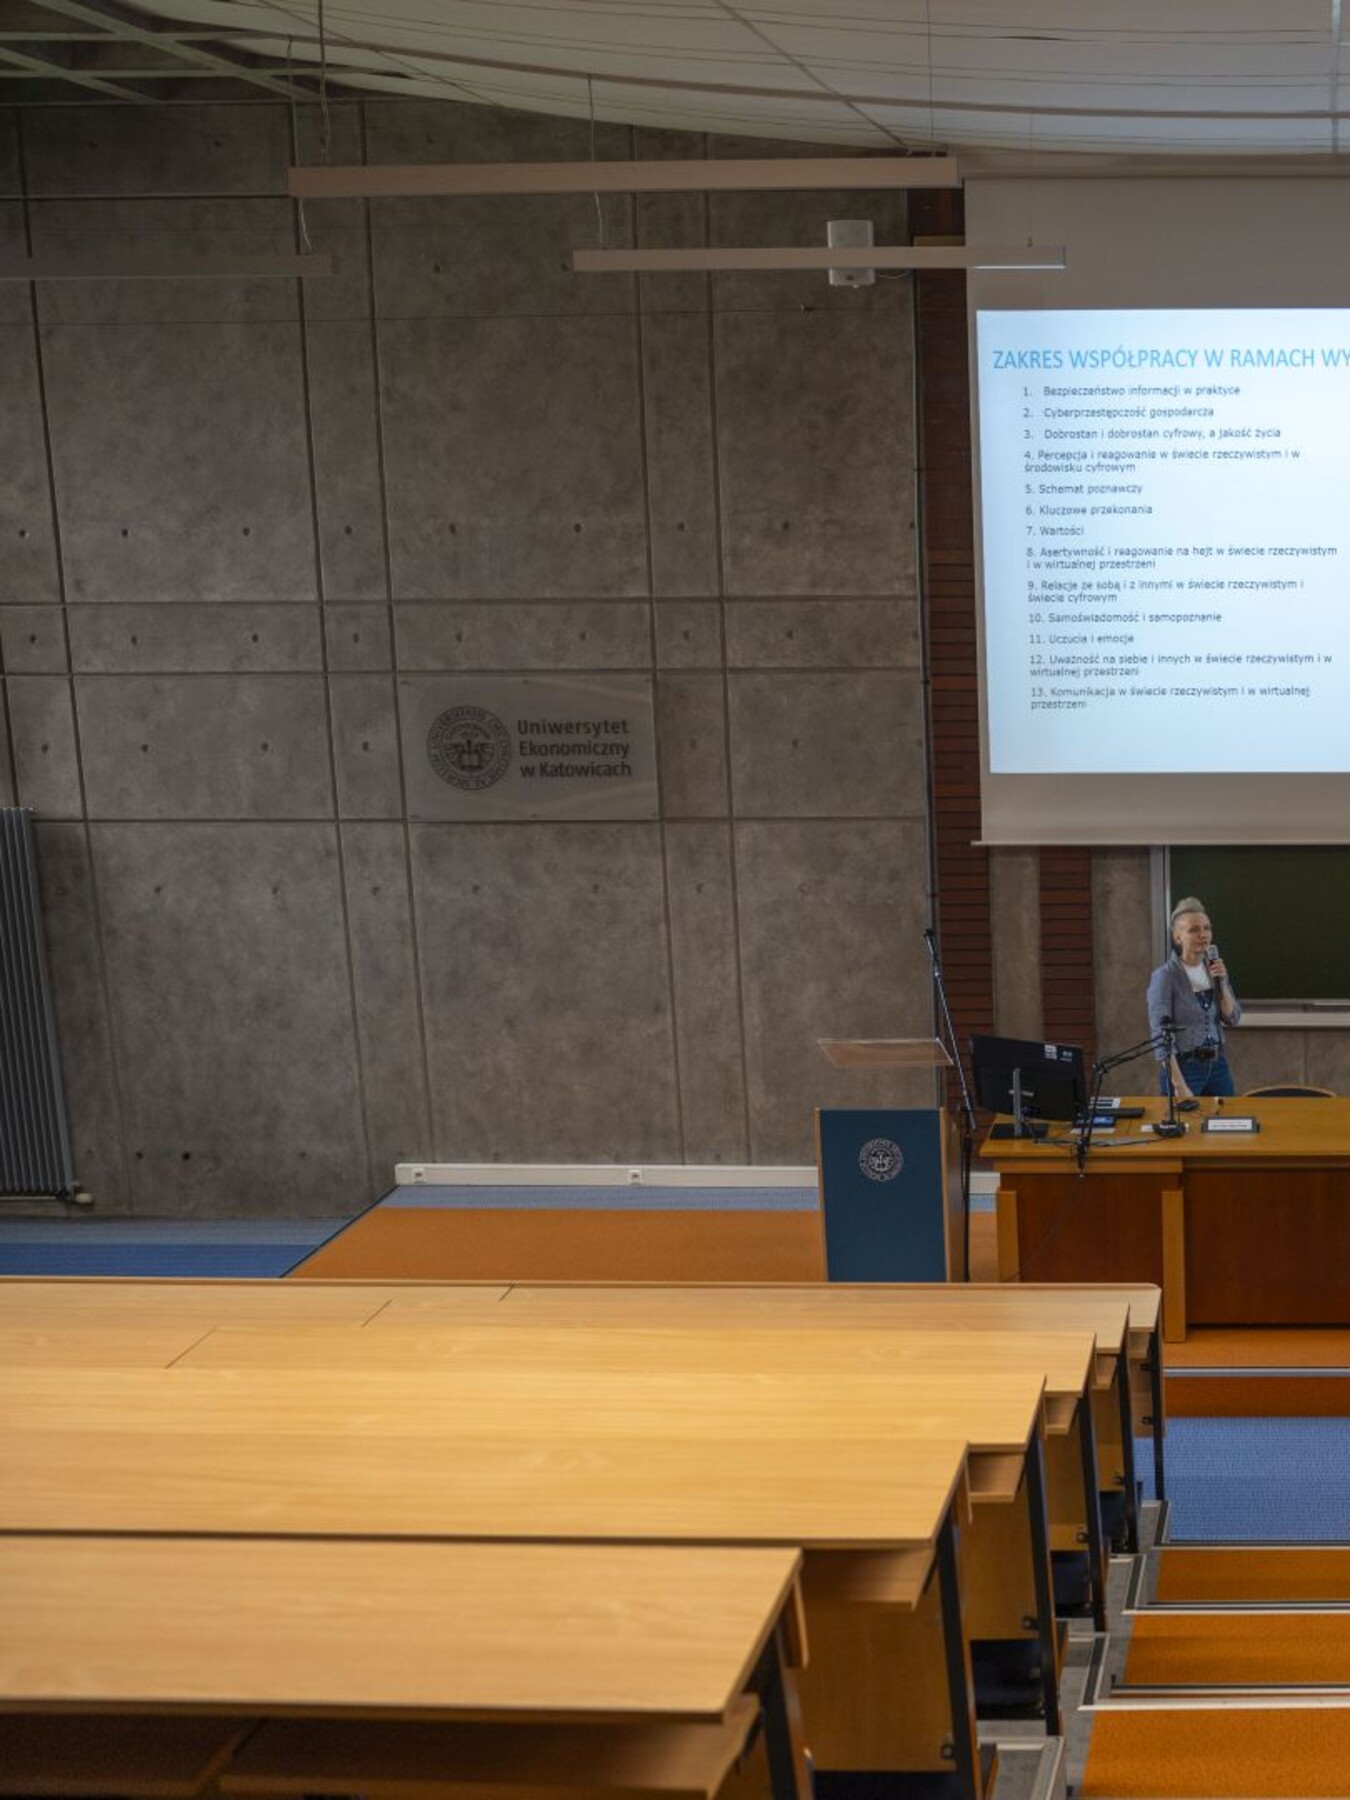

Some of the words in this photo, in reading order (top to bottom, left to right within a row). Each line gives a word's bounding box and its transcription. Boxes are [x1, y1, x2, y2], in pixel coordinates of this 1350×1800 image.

[993, 351, 1063, 369] ZAKRES
[1069, 346, 1198, 368] WSPÓŁPRACY
[1205, 350, 1225, 368] W
[1230, 350, 1314, 368] RAMACH
[1196, 385, 1240, 397] praktyce
[1162, 428, 1206, 440] cyfrowy,
[1218, 427, 1251, 439] jakość
[1171, 448, 1209, 458] świecie
[1086, 462, 1135, 473] cyfrowym
[1039, 484, 1084, 493] Schemat
[1039, 505, 1087, 514] Kluczowe
[1040, 525, 1084, 535] Wartości
[1176, 548, 1189, 556] na
[1192, 546, 1212, 558] hejt
[1228, 545, 1265, 555] świecie
[1041, 580, 1077, 591] Relacje
[1139, 580, 1172, 591] innymi
[1188, 579, 1224, 589] świecie
[1028, 592, 1064, 602] świecie
[1068, 593, 1117, 604] cyfrowym
[1049, 633, 1087, 643] Uczucia
[1097, 633, 1134, 644] emocje
[1103, 656, 1115, 664] na
[1119, 654, 1148, 664] siebie
[1158, 654, 1190, 665] innych
[1206, 653, 1242, 663] świecie
[1130, 686, 1167, 696] świecie
[517, 719, 629, 738] Uniwersytet
[519, 741, 630, 759] Ekonomiczny
[520, 765, 535, 778] w
[540, 762, 632, 778] Katowicach
